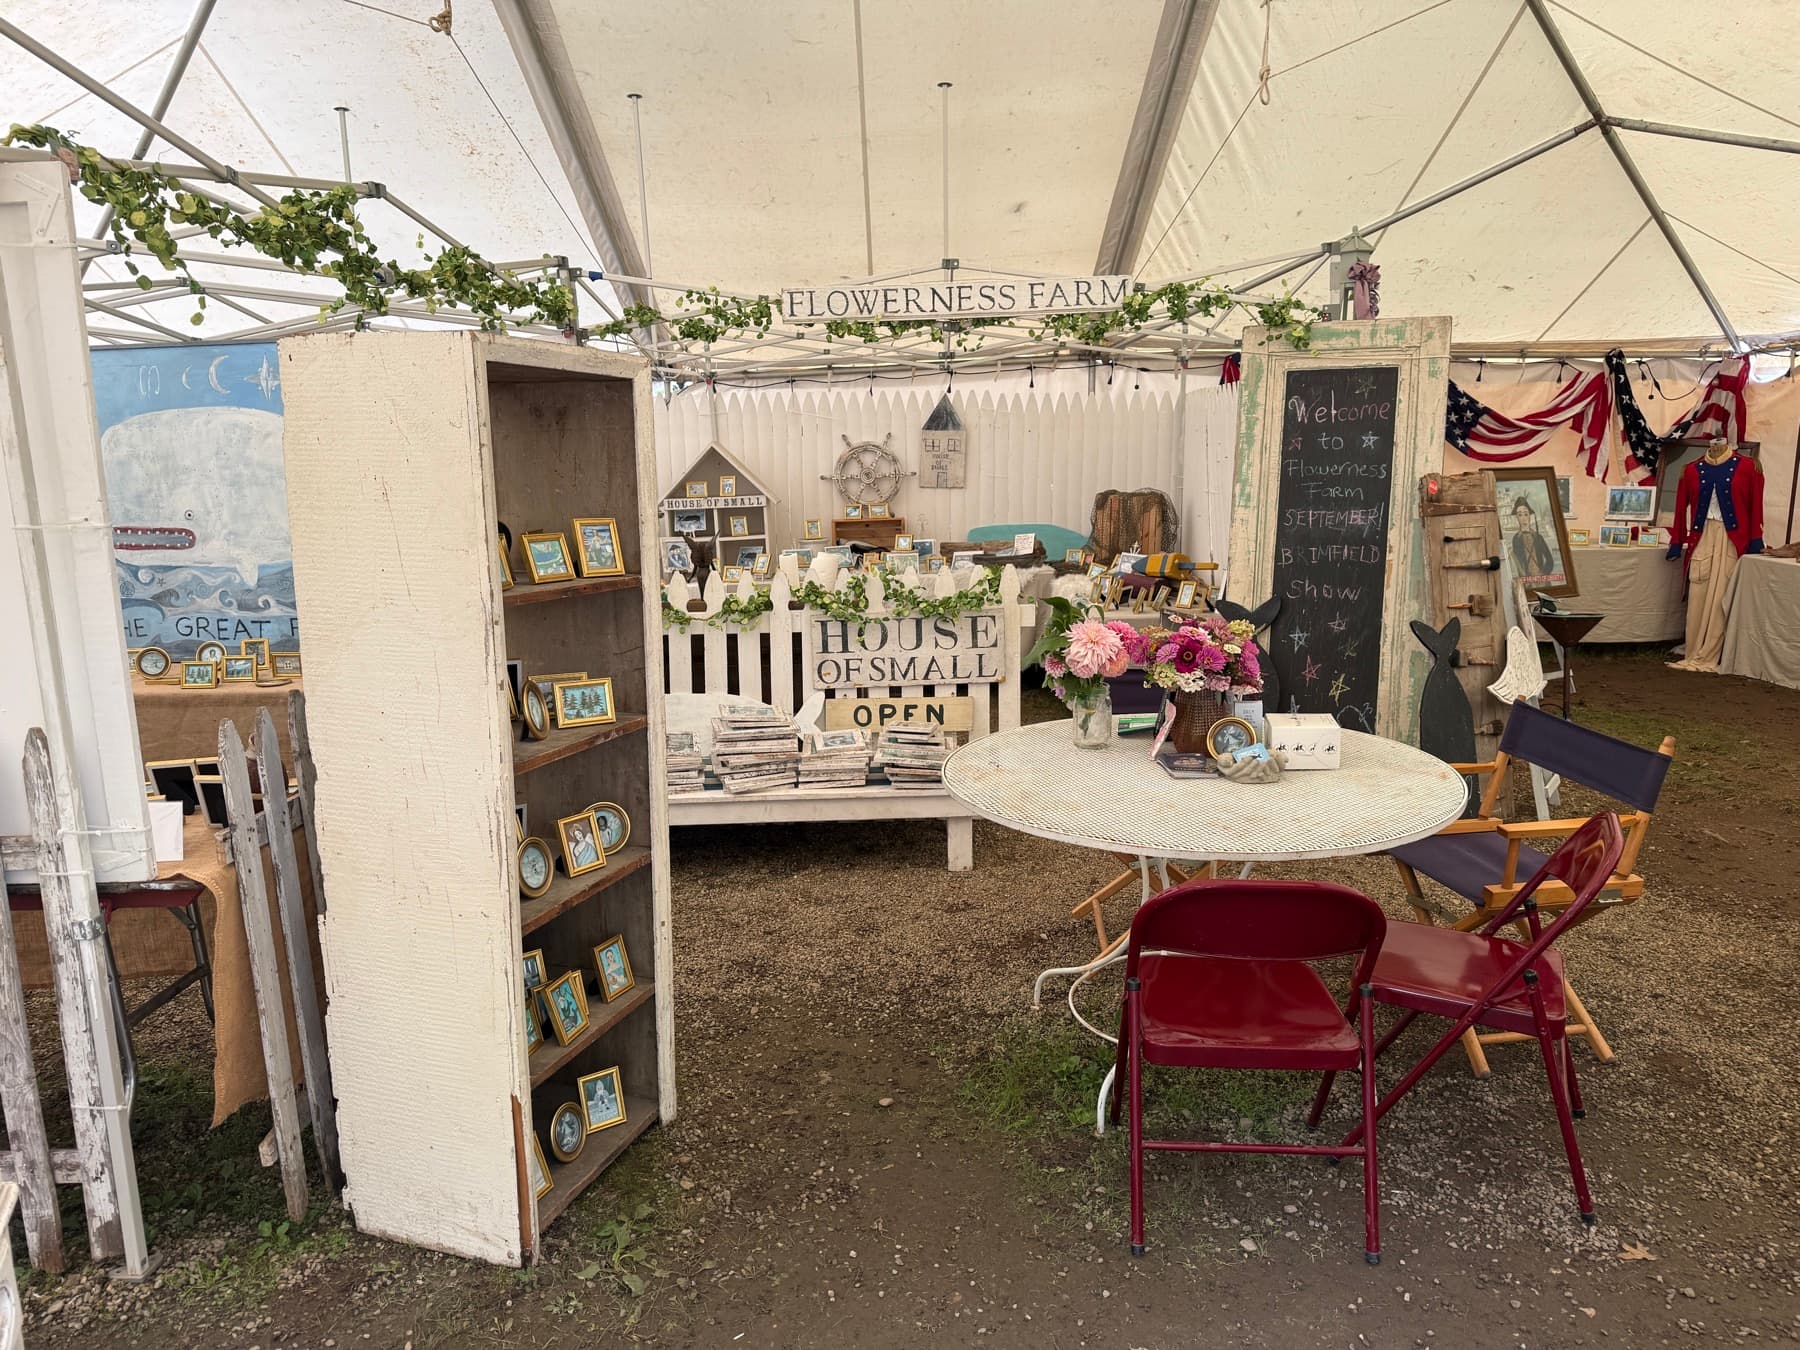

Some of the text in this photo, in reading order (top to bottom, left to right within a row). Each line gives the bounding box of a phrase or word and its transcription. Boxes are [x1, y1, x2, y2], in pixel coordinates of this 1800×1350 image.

[787, 278, 1128, 318] FLOWERNESS FARM
[1288, 389, 1391, 424] Welcome
[1317, 432, 1344, 450] to
[1284, 459, 1387, 479] Flowerness
[667, 497, 763, 509] HOUSE OF SMALL
[1286, 578, 1361, 600] Show
[175, 616, 271, 641] GREAT
[815, 615, 998, 654] HOUSE
[817, 653, 998, 684] OF SMALL
